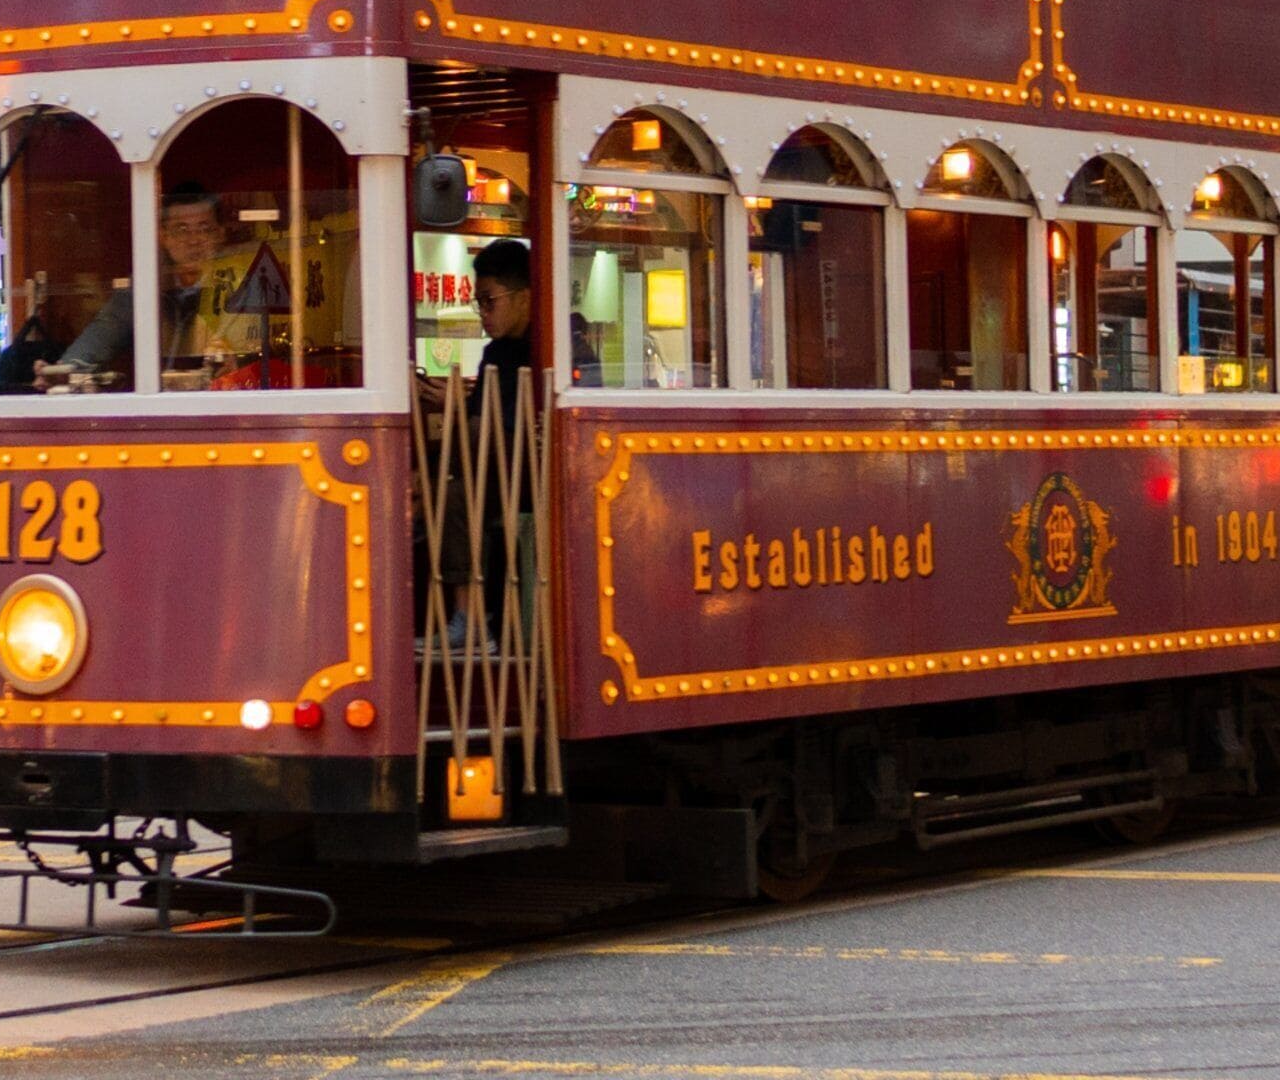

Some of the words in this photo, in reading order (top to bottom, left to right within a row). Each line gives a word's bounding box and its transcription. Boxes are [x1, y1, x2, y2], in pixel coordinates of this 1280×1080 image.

[691, 521, 934, 592] Established
[1171, 514, 1200, 568] in
[1216, 509, 1278, 563] 1904
